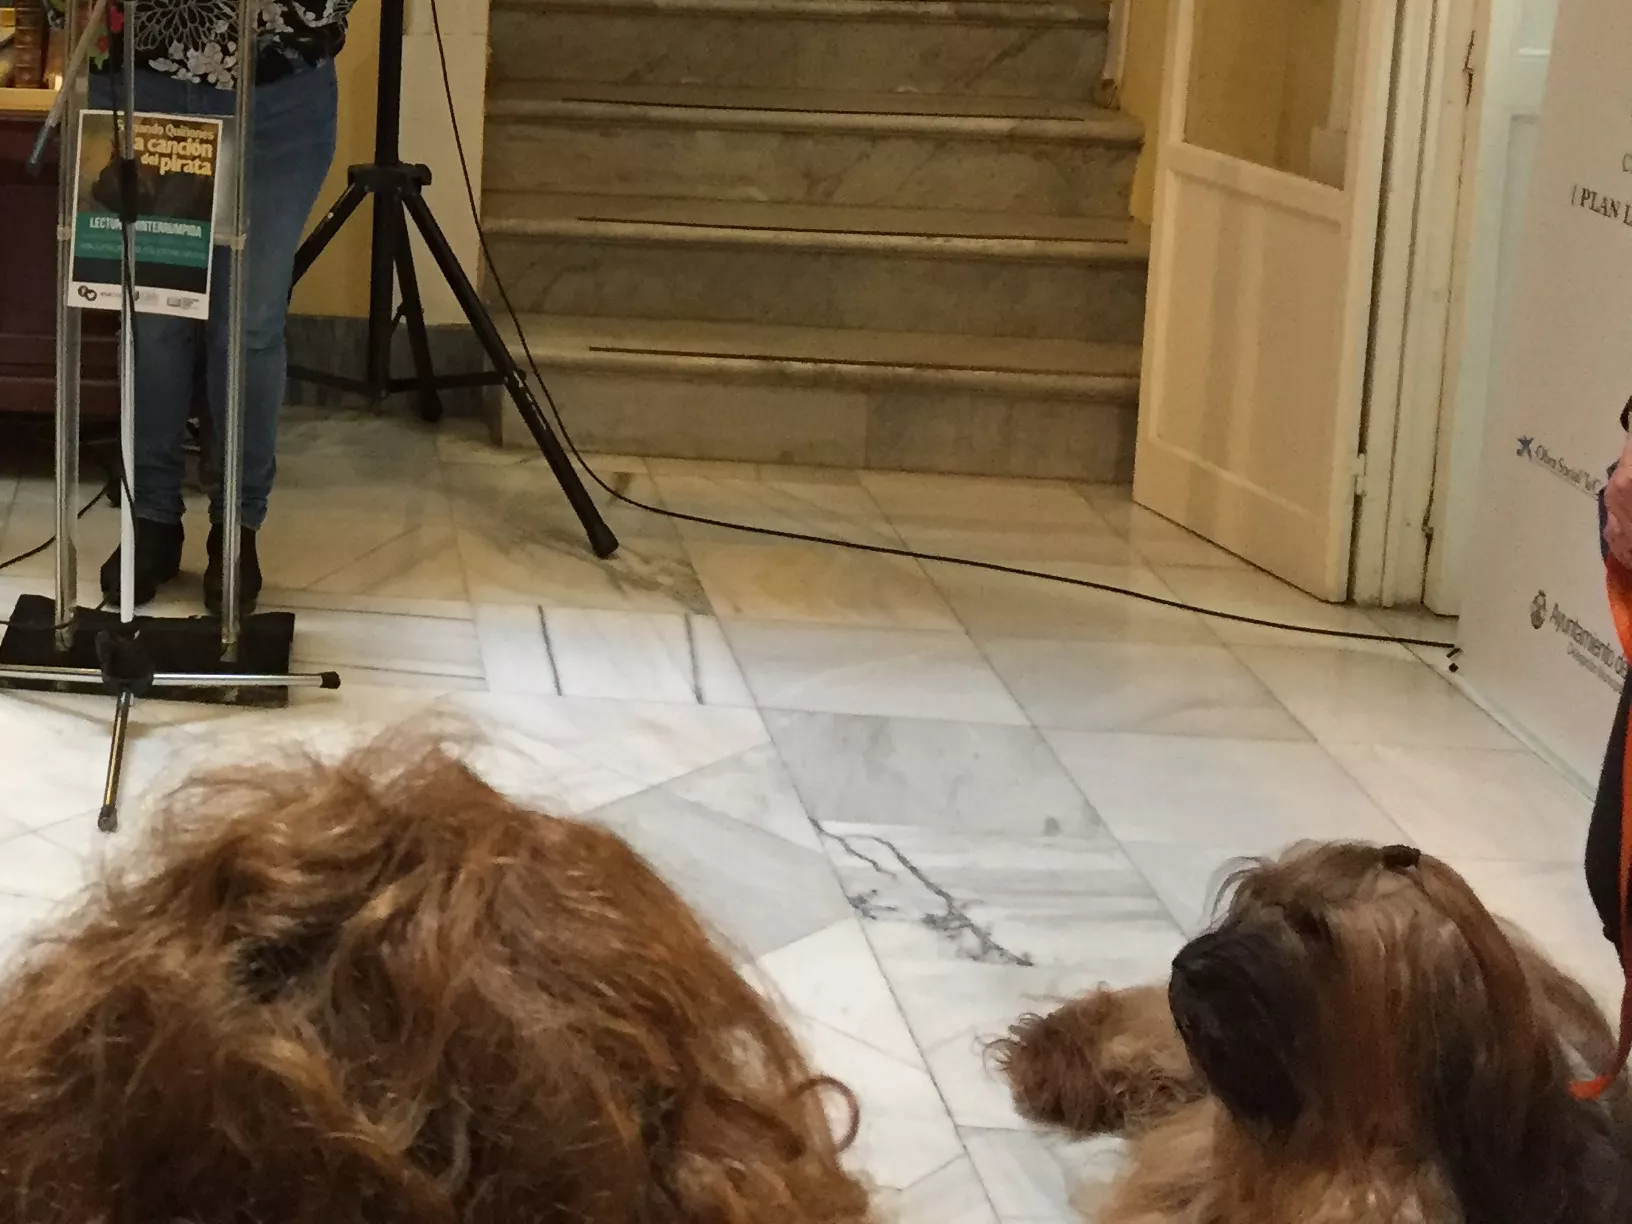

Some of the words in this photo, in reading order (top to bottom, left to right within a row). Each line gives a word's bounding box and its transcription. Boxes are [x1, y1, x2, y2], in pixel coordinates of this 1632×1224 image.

[146, 137, 213, 159] canción
[140, 152, 160, 166] del
[159, 153, 212, 176] pirata
[1580, 187, 1621, 219] PLAN
[1549, 602, 1614, 669] Ayuntamiento
